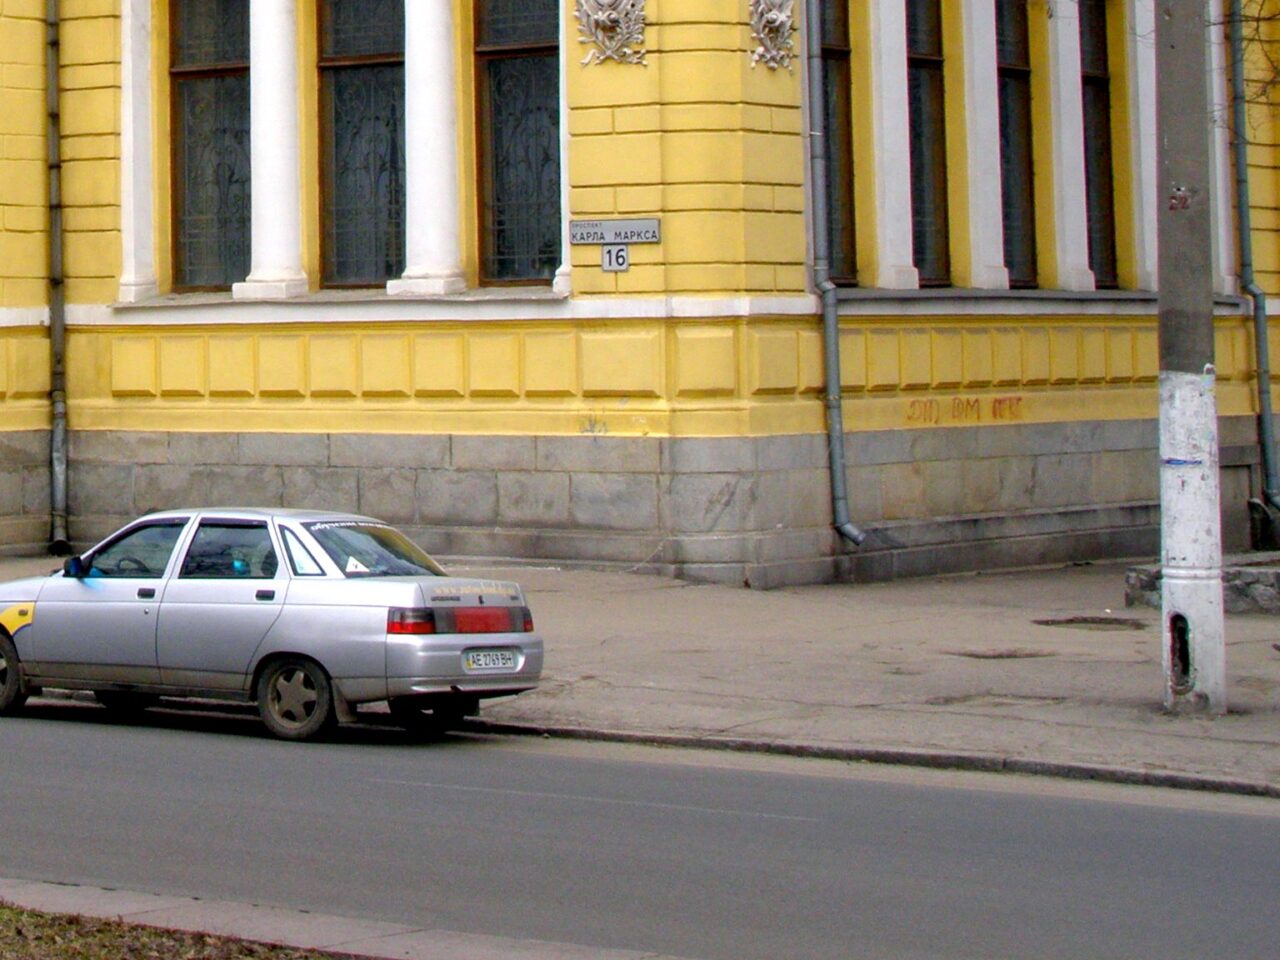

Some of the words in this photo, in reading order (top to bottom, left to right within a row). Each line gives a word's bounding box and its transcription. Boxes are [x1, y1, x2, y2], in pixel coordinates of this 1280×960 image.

[571, 231, 606, 241] КАРЛА
[613, 229, 658, 241] МАРКСА
[605, 248, 627, 267] 16
